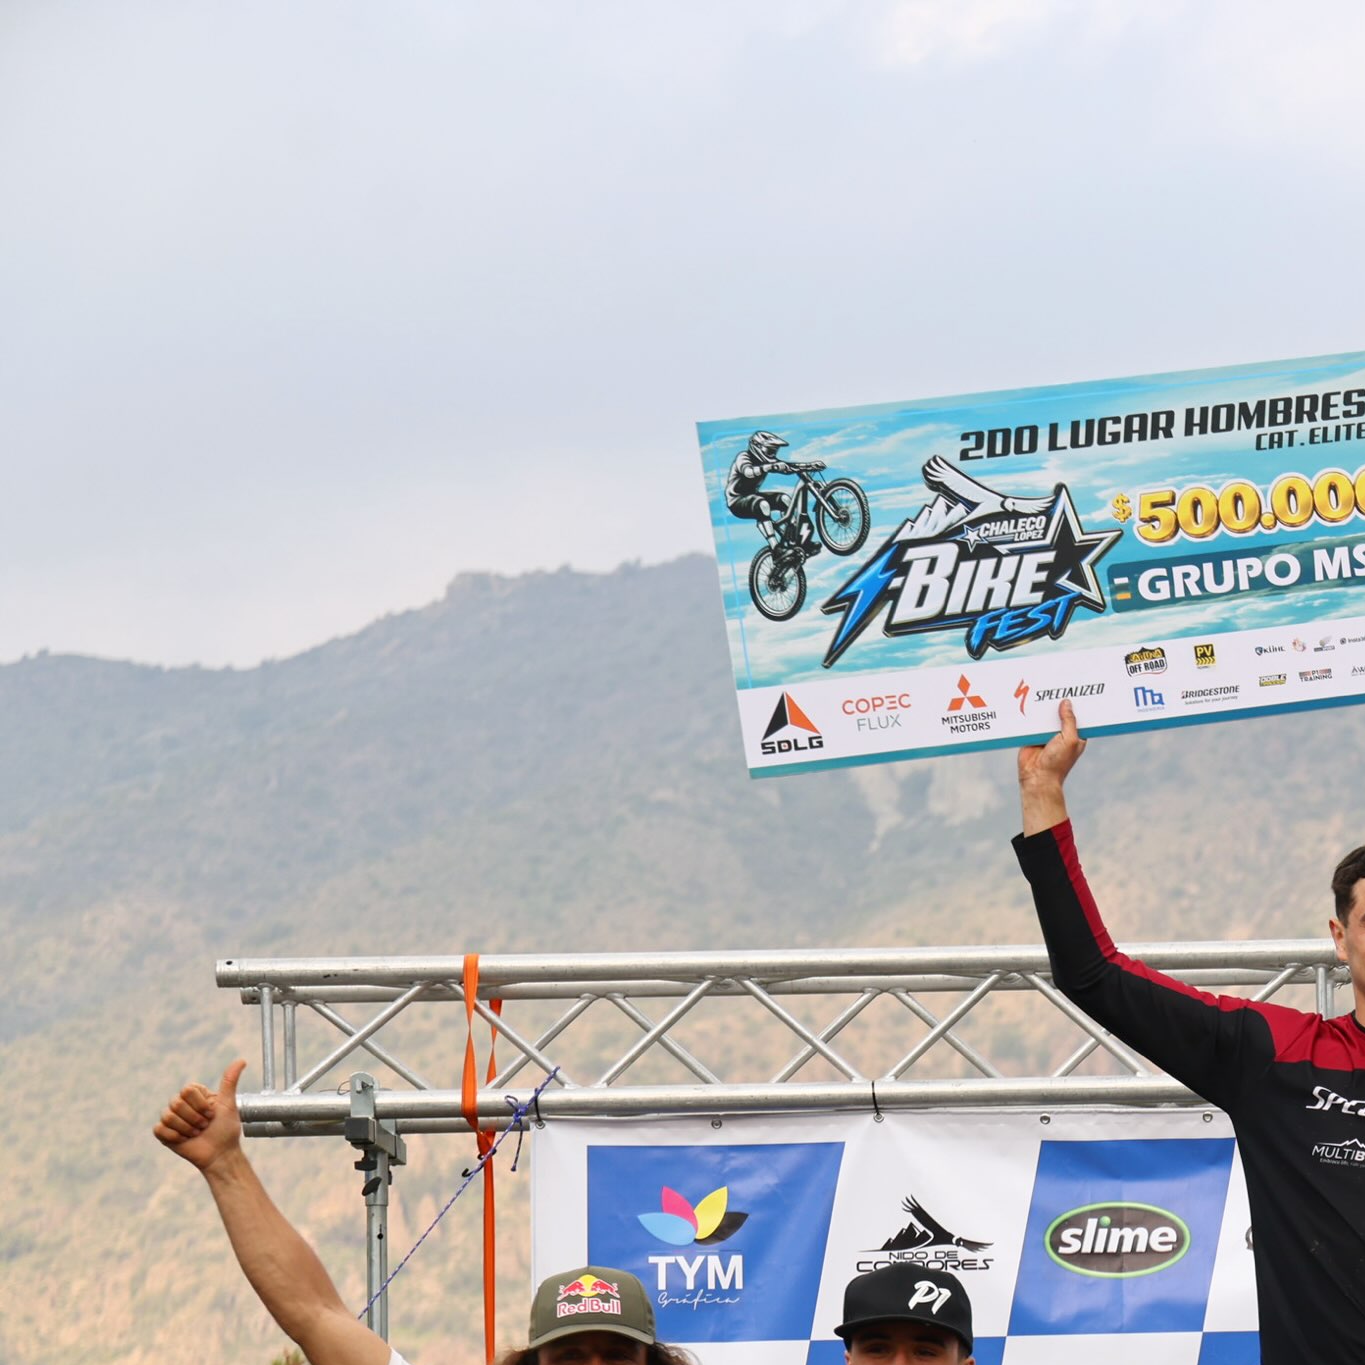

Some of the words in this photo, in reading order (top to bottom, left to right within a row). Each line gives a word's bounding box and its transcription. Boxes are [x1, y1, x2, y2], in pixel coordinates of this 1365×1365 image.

[959, 425, 1039, 461] 2DO
[1048, 410, 1175, 452] LUGAR
[977, 515, 1047, 538] CHALECO
[1013, 529, 1044, 541] LOPEZ
[1137, 553, 1301, 601] GRUPO
[967, 591, 1083, 651] FEST
[1129, 661, 1142, 674] OFF
[1144, 658, 1166, 672] ROAD
[1300, 673, 1333, 683] TRAINING
[1034, 683, 1105, 702] SPECIALIZED
[1181, 685, 1240, 700] BRIDGESTONE
[842, 693, 912, 716] COPEC
[857, 714, 902, 732] FLUX
[941, 711, 997, 726] MITSUBISHI
[950, 721, 991, 734] MOTORS
[761, 735, 824, 756] SDLG
[1057, 1216, 1177, 1255] slime
[889, 1250, 932, 1260] NIDO
[934, 1250, 959, 1260] DE
[648, 1255, 744, 1291] TYM
[556, 1298, 589, 1319] Red
[589, 1296, 622, 1316] Bull
